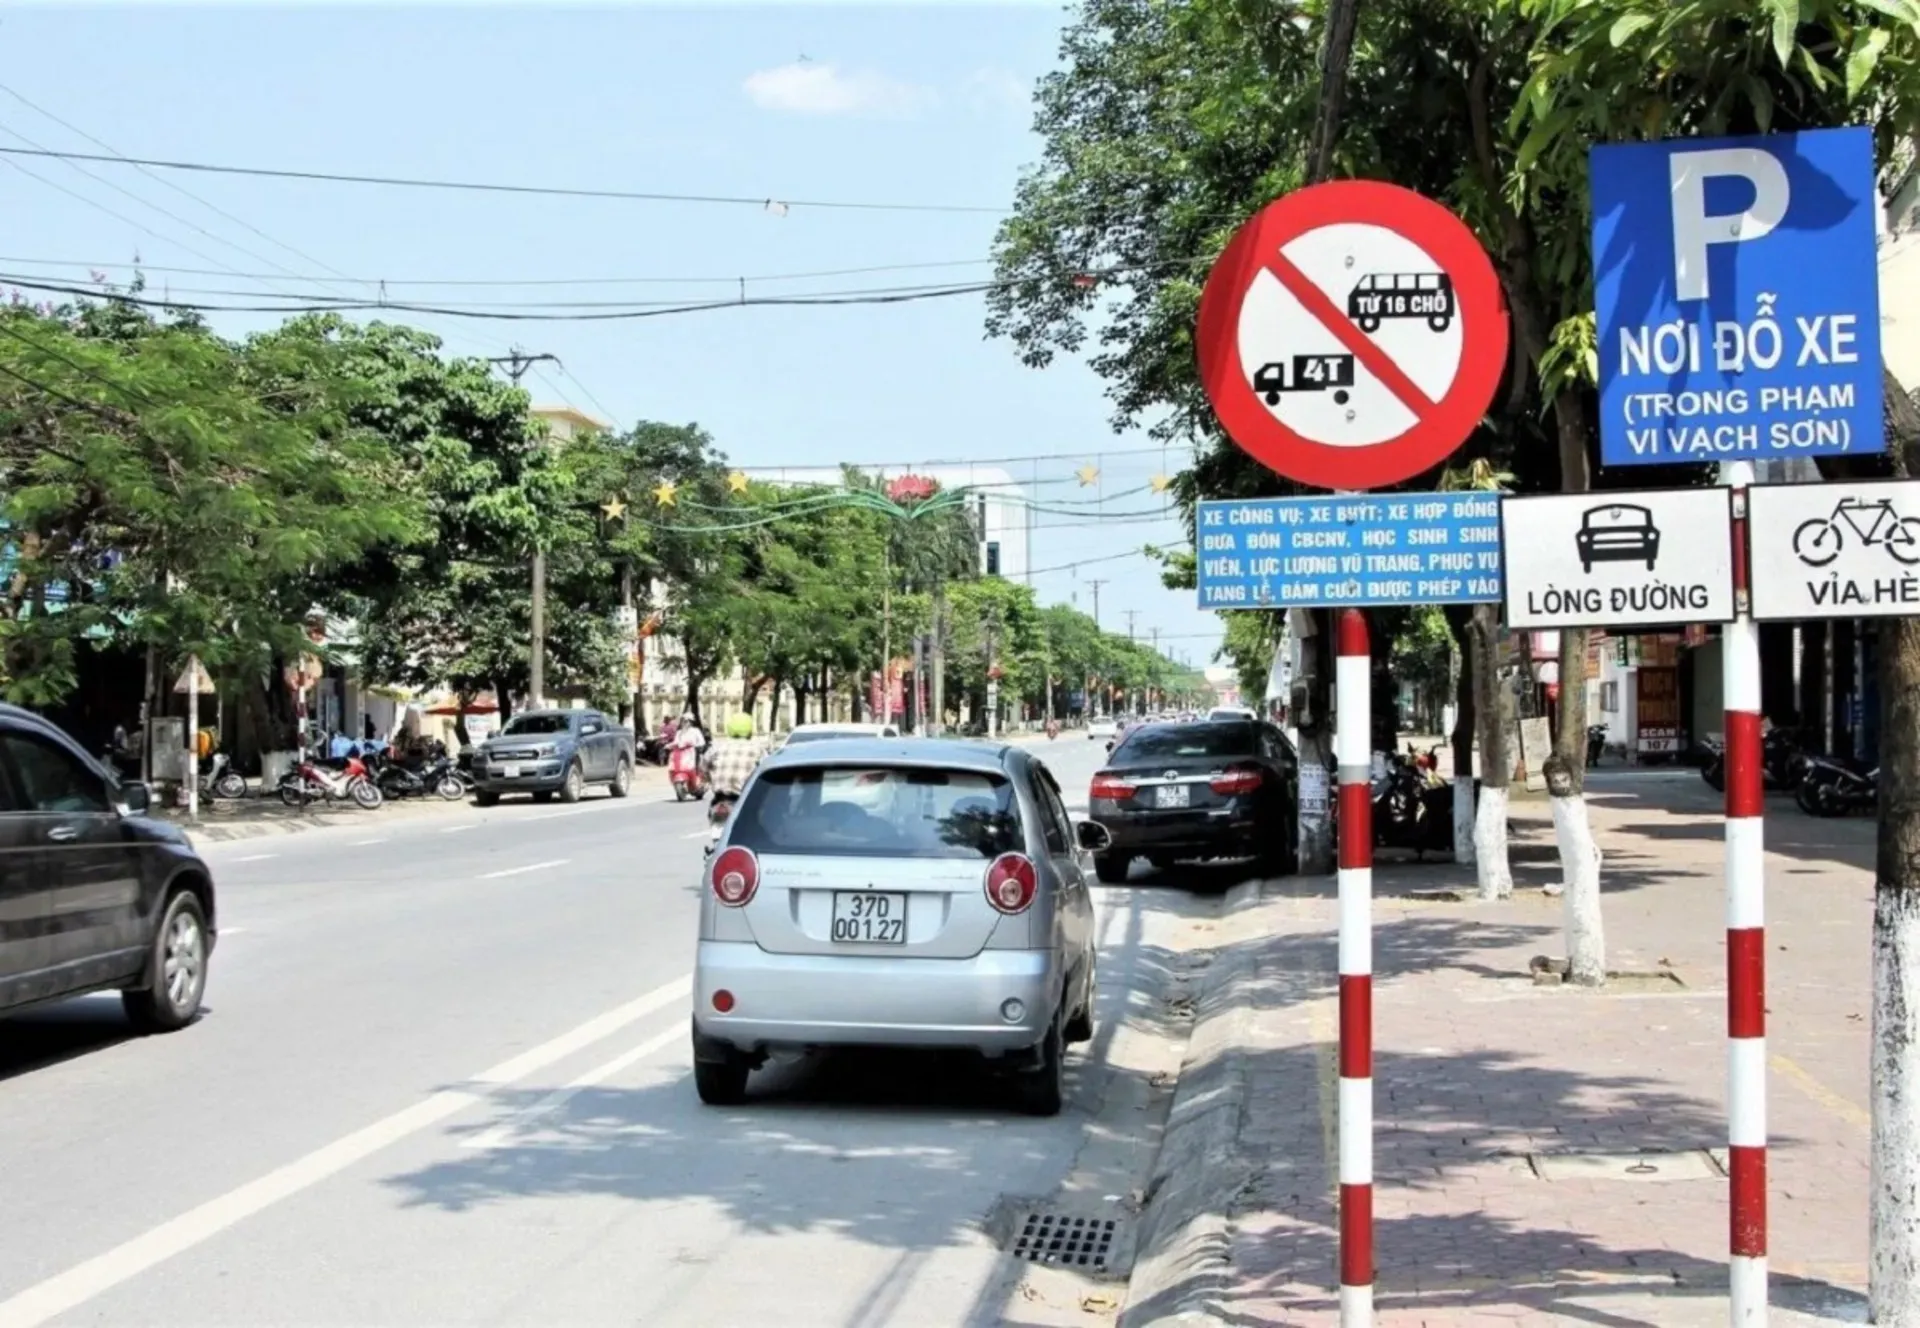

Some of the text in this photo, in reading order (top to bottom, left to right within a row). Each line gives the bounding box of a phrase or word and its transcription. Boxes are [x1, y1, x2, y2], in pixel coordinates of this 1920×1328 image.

[1669, 148, 1790, 301] P
[1357, 289, 1448, 314] TỪ 16 CHỖ
[1619, 319, 1700, 376] NƠI
[1795, 314, 1859, 368] XE
[1303, 358, 1343, 382] 4T
[1623, 383, 1855, 425] (TRONG PHẠM
[1625, 418, 1851, 458] VI VẠCH SƠN)
[1203, 509, 1224, 526] XE
[1229, 506, 1274, 525] CÔNG
[1278, 507, 1305, 527] VỤ;
[1309, 506, 1331, 523] XE
[1388, 504, 1408, 521] XE
[1413, 502, 1448, 523] HỢP
[1362, 529, 1396, 551] HỌC
[1407, 527, 1448, 546] SINH
[1458, 526, 1498, 544] SINH
[1203, 556, 1245, 578] VIÊN,
[1284, 555, 1337, 578] LƯỢNG
[1341, 553, 1362, 574] VŨ
[1366, 553, 1425, 573] TRANG,
[1428, 552, 1473, 574] PHỤC
[1477, 551, 1499, 573] VỤ
[1204, 584, 1246, 602] TANG
[1367, 579, 1412, 601] ĐƯỢC
[1418, 576, 1462, 597] PHÉP
[1467, 576, 1499, 595] VÀO
[1528, 578, 1709, 615] LÒNG ĐƯỜNG
[1806, 570, 1920, 605] VỈA HÈ
[1640, 728, 1675, 737] SCAN
[1646, 740, 1670, 750] 107
[835, 918, 903, 941] 001.27
